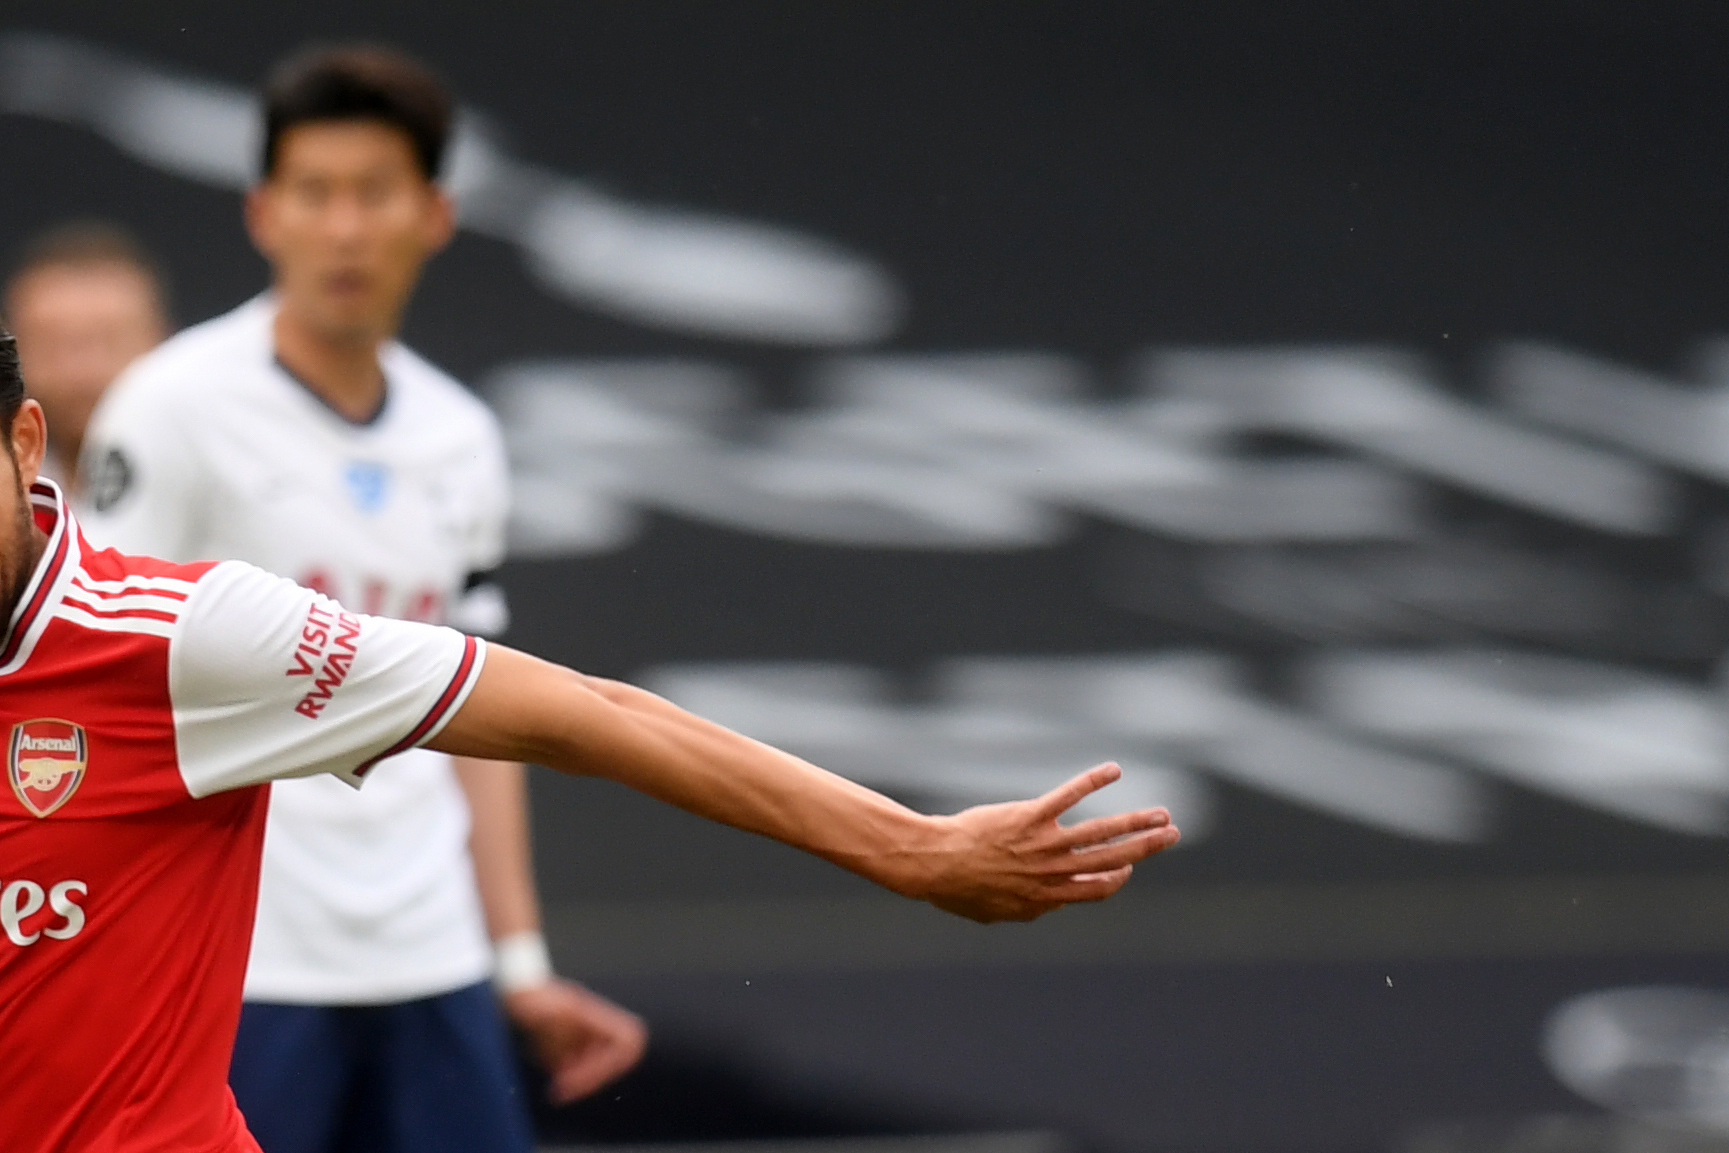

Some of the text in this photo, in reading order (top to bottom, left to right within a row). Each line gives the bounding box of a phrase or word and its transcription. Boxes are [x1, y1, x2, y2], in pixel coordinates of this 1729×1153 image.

[286, 602, 333, 676] VISIT
[294, 612, 361, 720] RWAND
[20, 734, 77, 751] Arsenal
